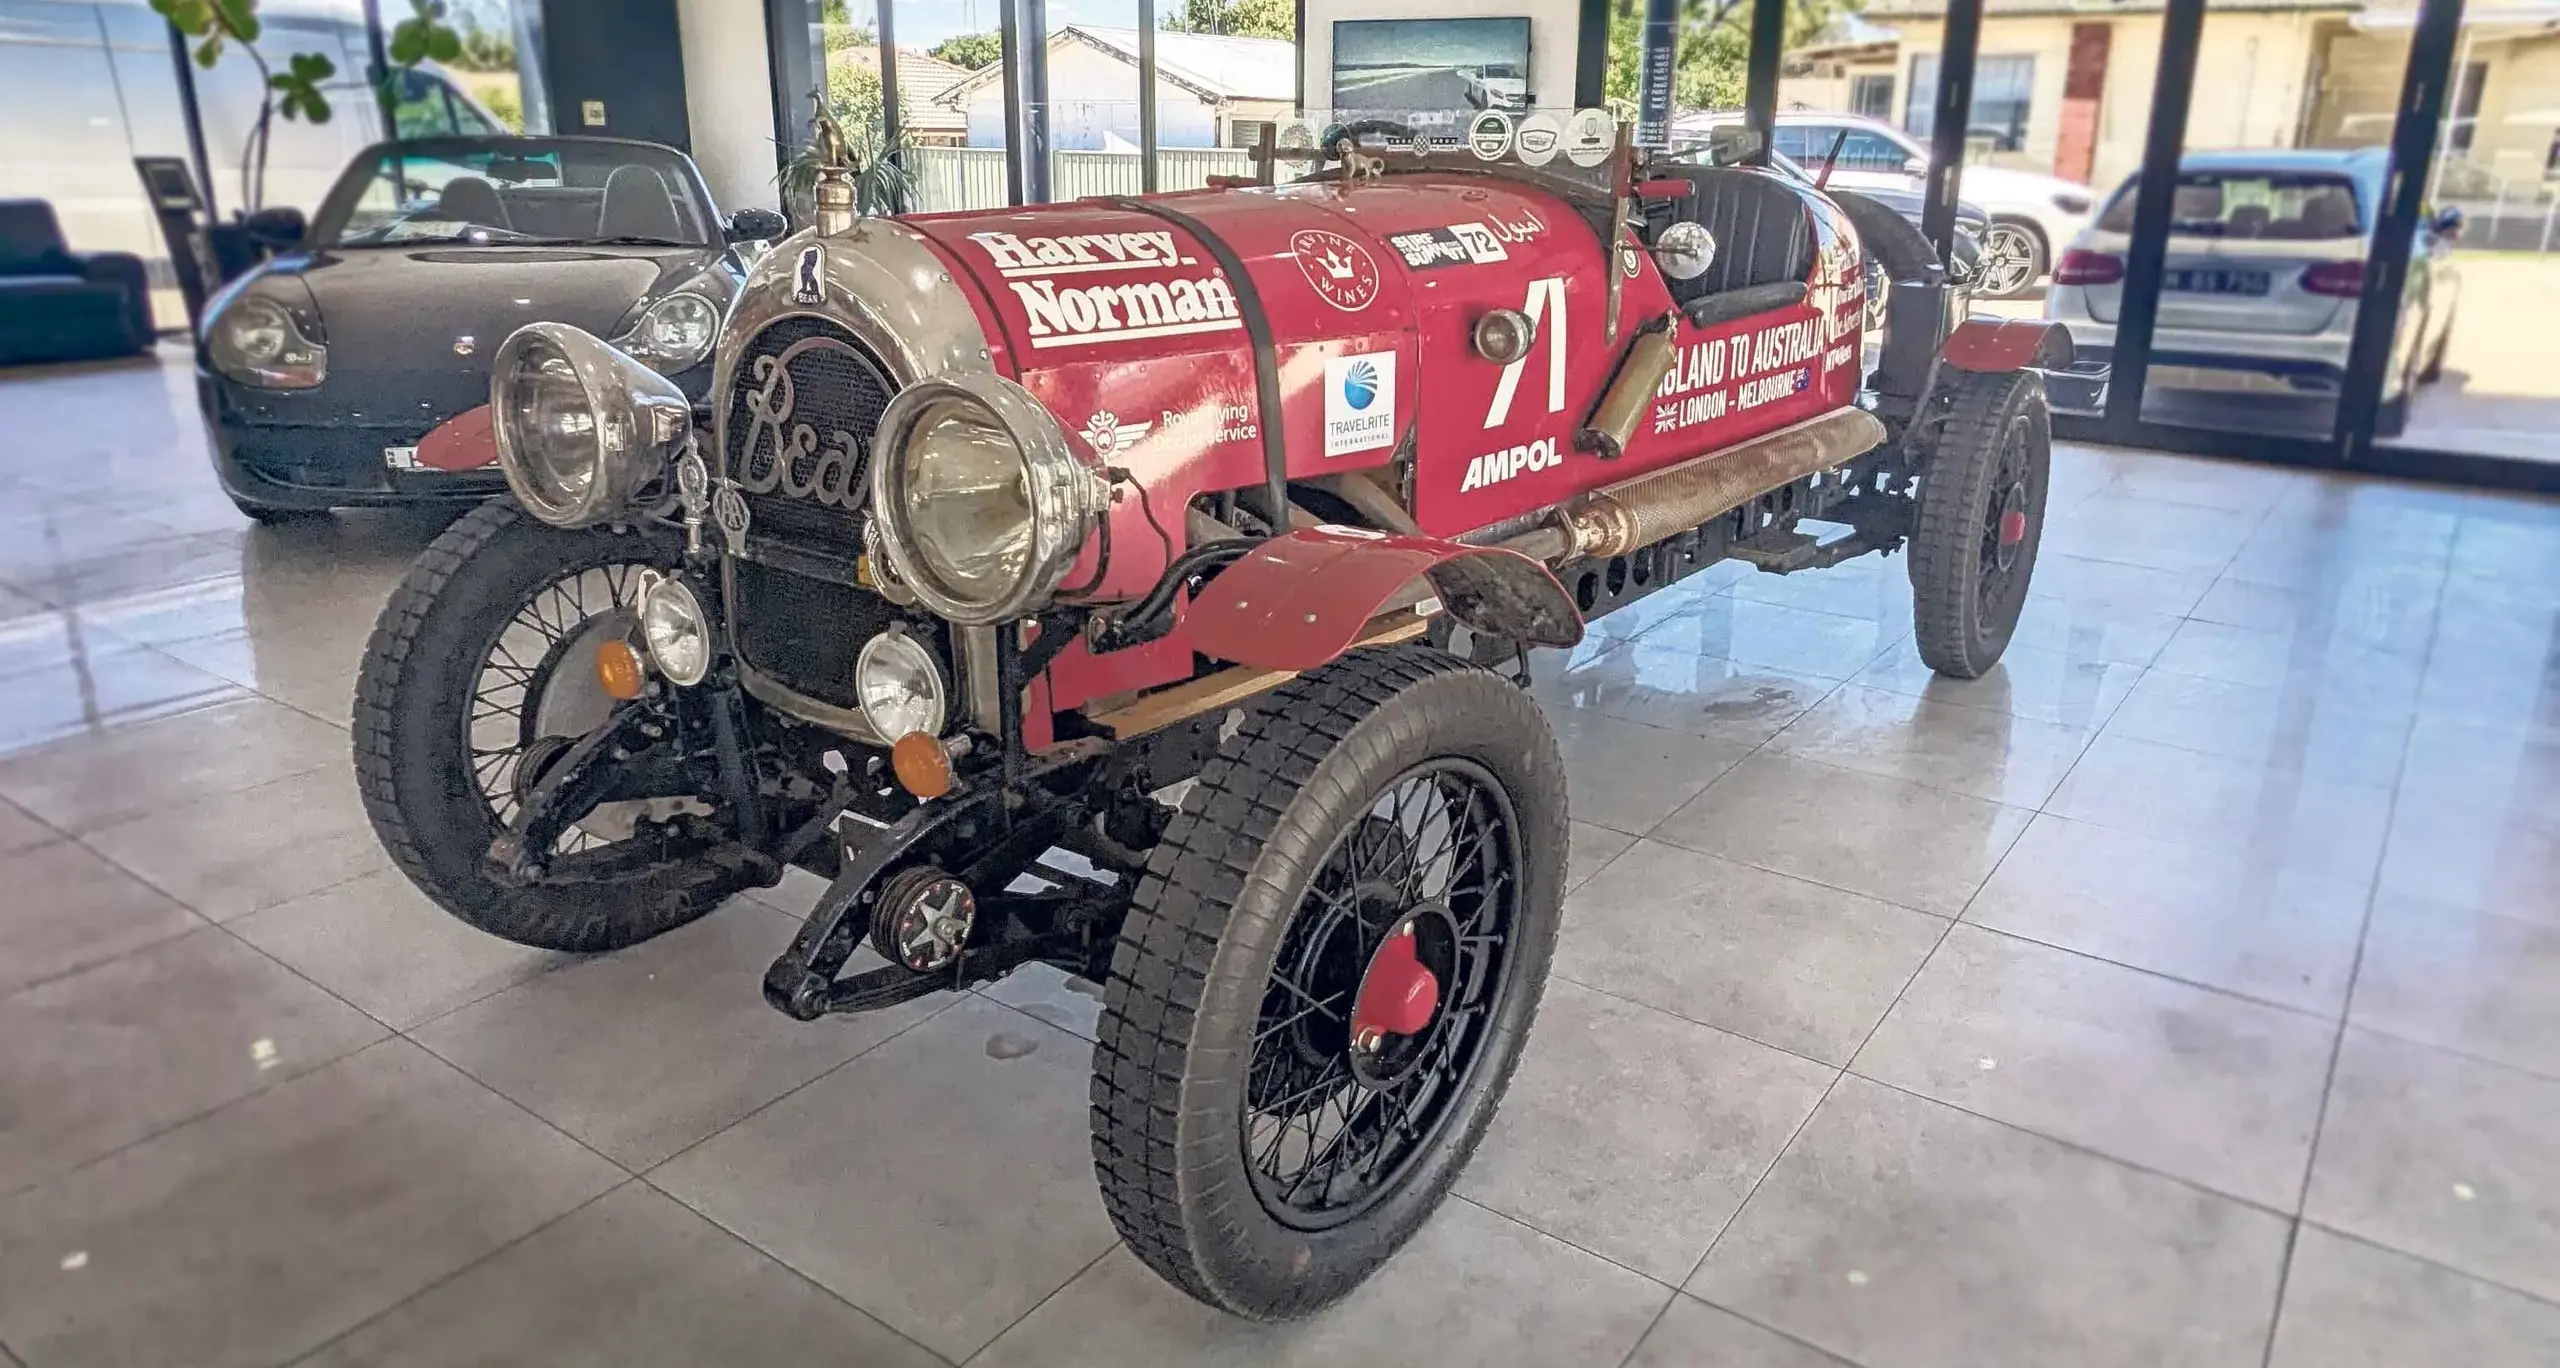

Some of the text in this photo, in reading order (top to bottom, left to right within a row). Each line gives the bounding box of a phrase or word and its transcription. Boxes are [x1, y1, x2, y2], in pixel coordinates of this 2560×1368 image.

[967, 231, 1178, 267] Harvey
[1298, 233, 1356, 254] IRVINE
[1390, 232, 1434, 251] SURF
[1459, 230, 1498, 255] 72
[798, 291, 818, 304] BEAN
[1009, 275, 1238, 335] Norman
[1321, 274, 1373, 305] WINES
[1657, 339, 1726, 397] GLAND
[1730, 333, 1751, 380] TO
[1751, 315, 1825, 374] AUSTRALIA
[1680, 389, 1727, 427] LONDON
[1737, 369, 1797, 412] MELBOURNE
[739, 336, 892, 512] Bea
[1161, 403, 1248, 430] Roya ying
[1329, 414, 1390, 437] TRAVELRITE
[1206, 423, 1258, 445] ervice
[1460, 436, 1562, 493] AMPOL
